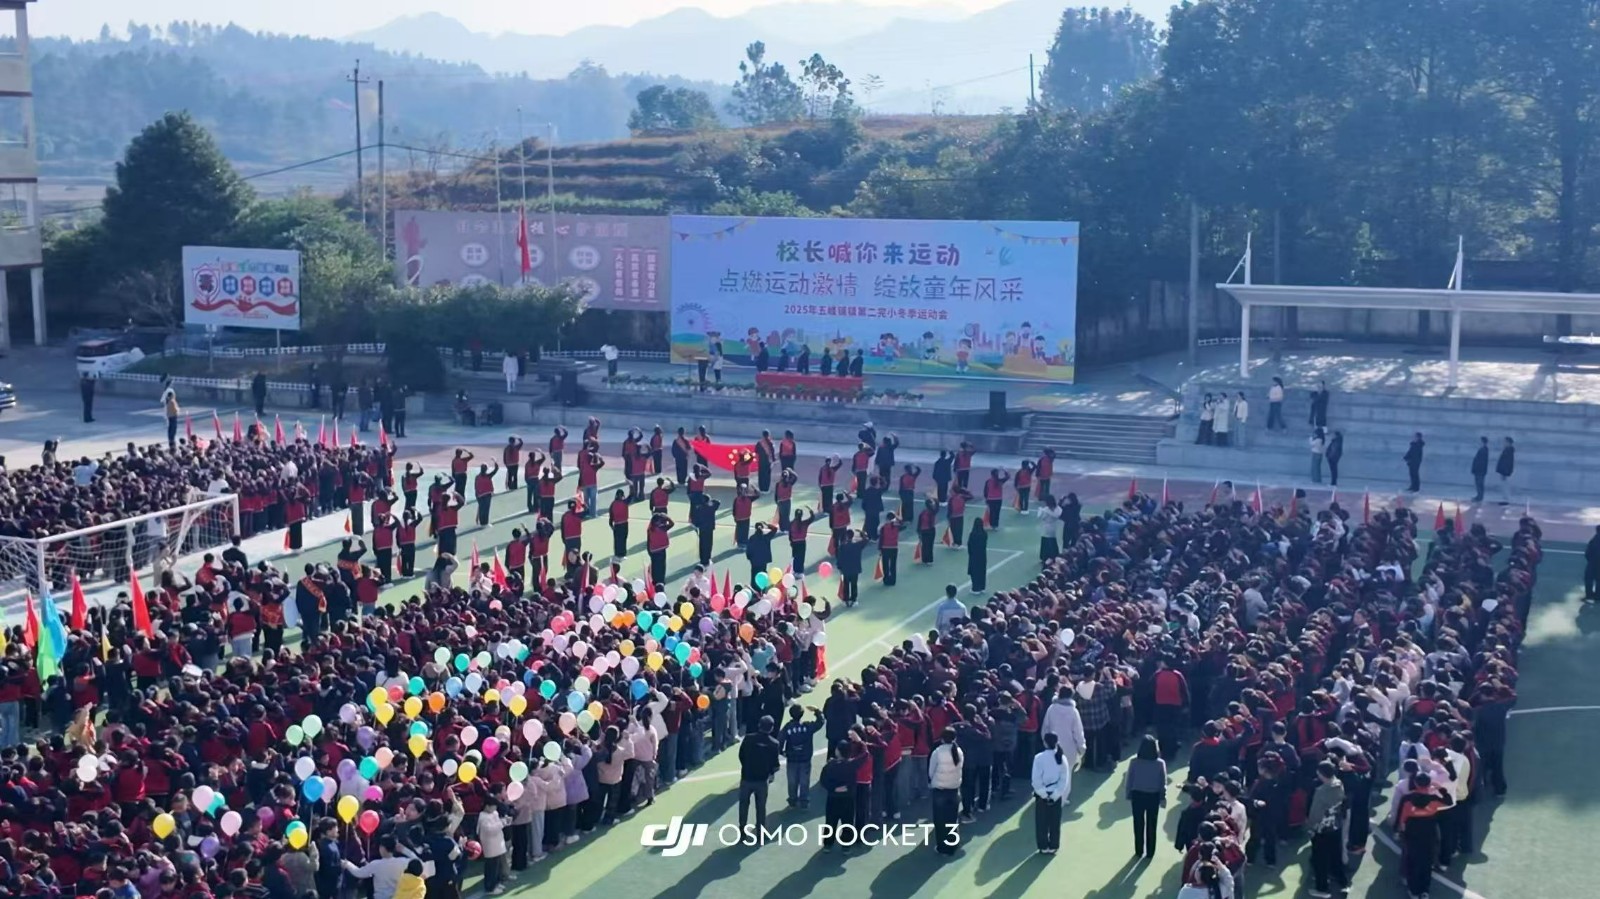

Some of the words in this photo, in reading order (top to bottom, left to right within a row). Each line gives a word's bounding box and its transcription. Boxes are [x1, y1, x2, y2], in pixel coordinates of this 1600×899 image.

[776, 239, 960, 267] 校长喊你来运动
[718, 268, 858, 297] 点燃运动激情
[873, 273, 1024, 302] 绽放童年风采
